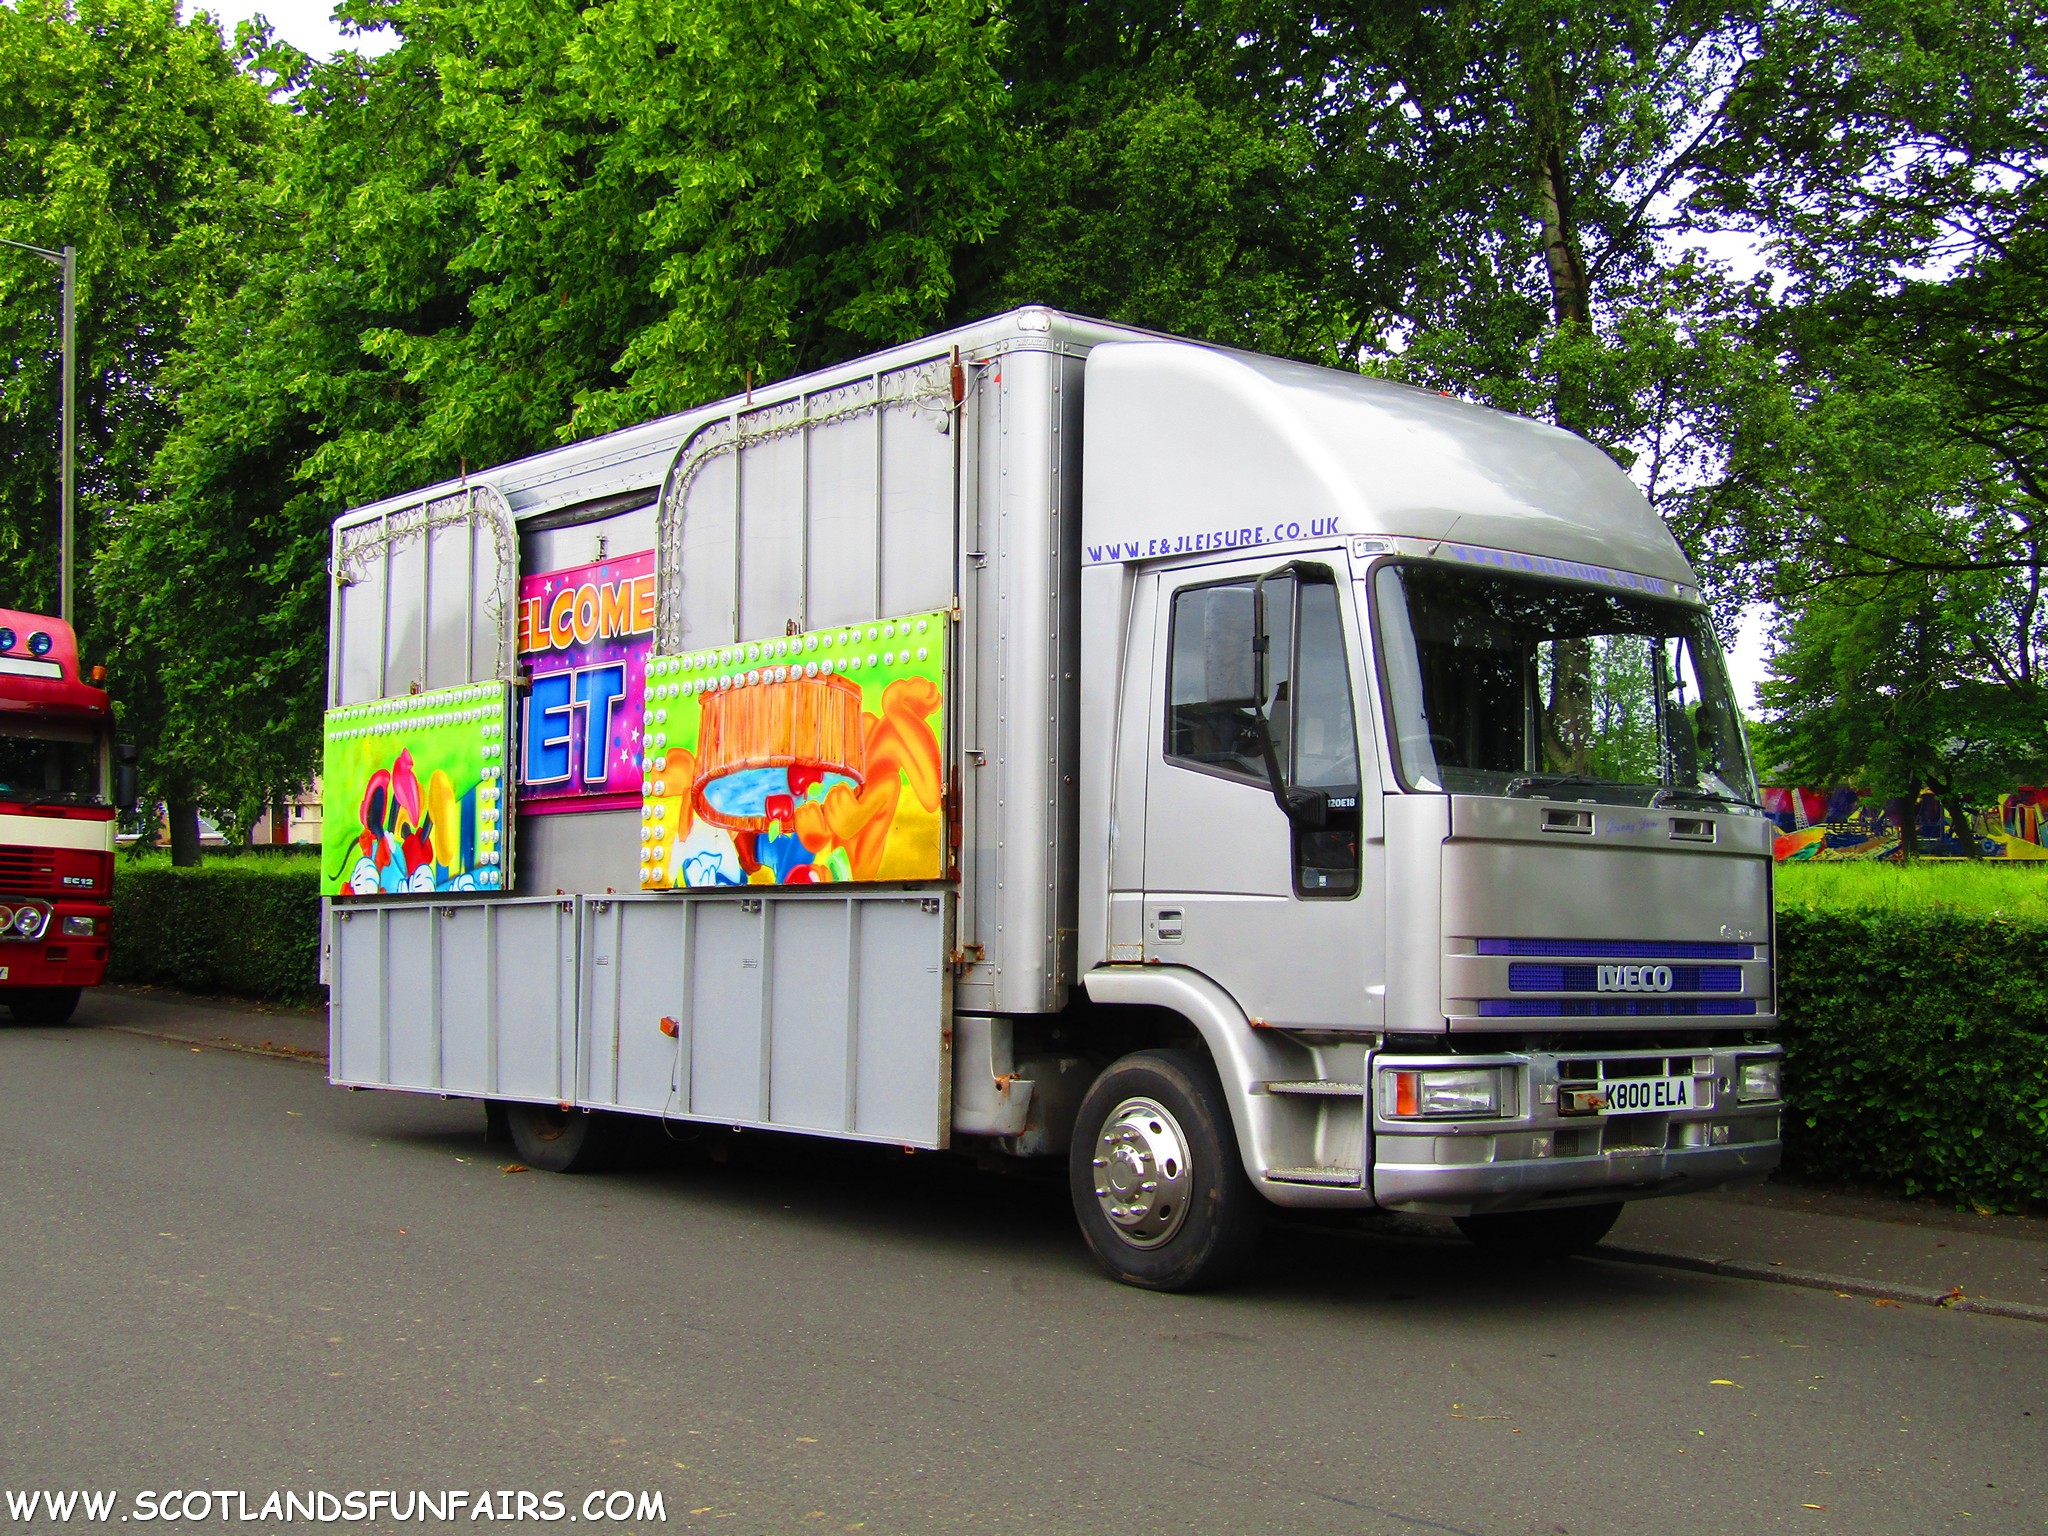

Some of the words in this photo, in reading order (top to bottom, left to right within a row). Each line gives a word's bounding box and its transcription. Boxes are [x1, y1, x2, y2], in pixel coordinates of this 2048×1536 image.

[1087, 516, 1340, 562] WWW.E&JLEISURE.CO.UK
[63, 876, 94, 885] EC12
[1597, 965, 1673, 992] IVECO
[1606, 1082, 1650, 1110] K800
[1655, 1080, 1686, 1106] ELA
